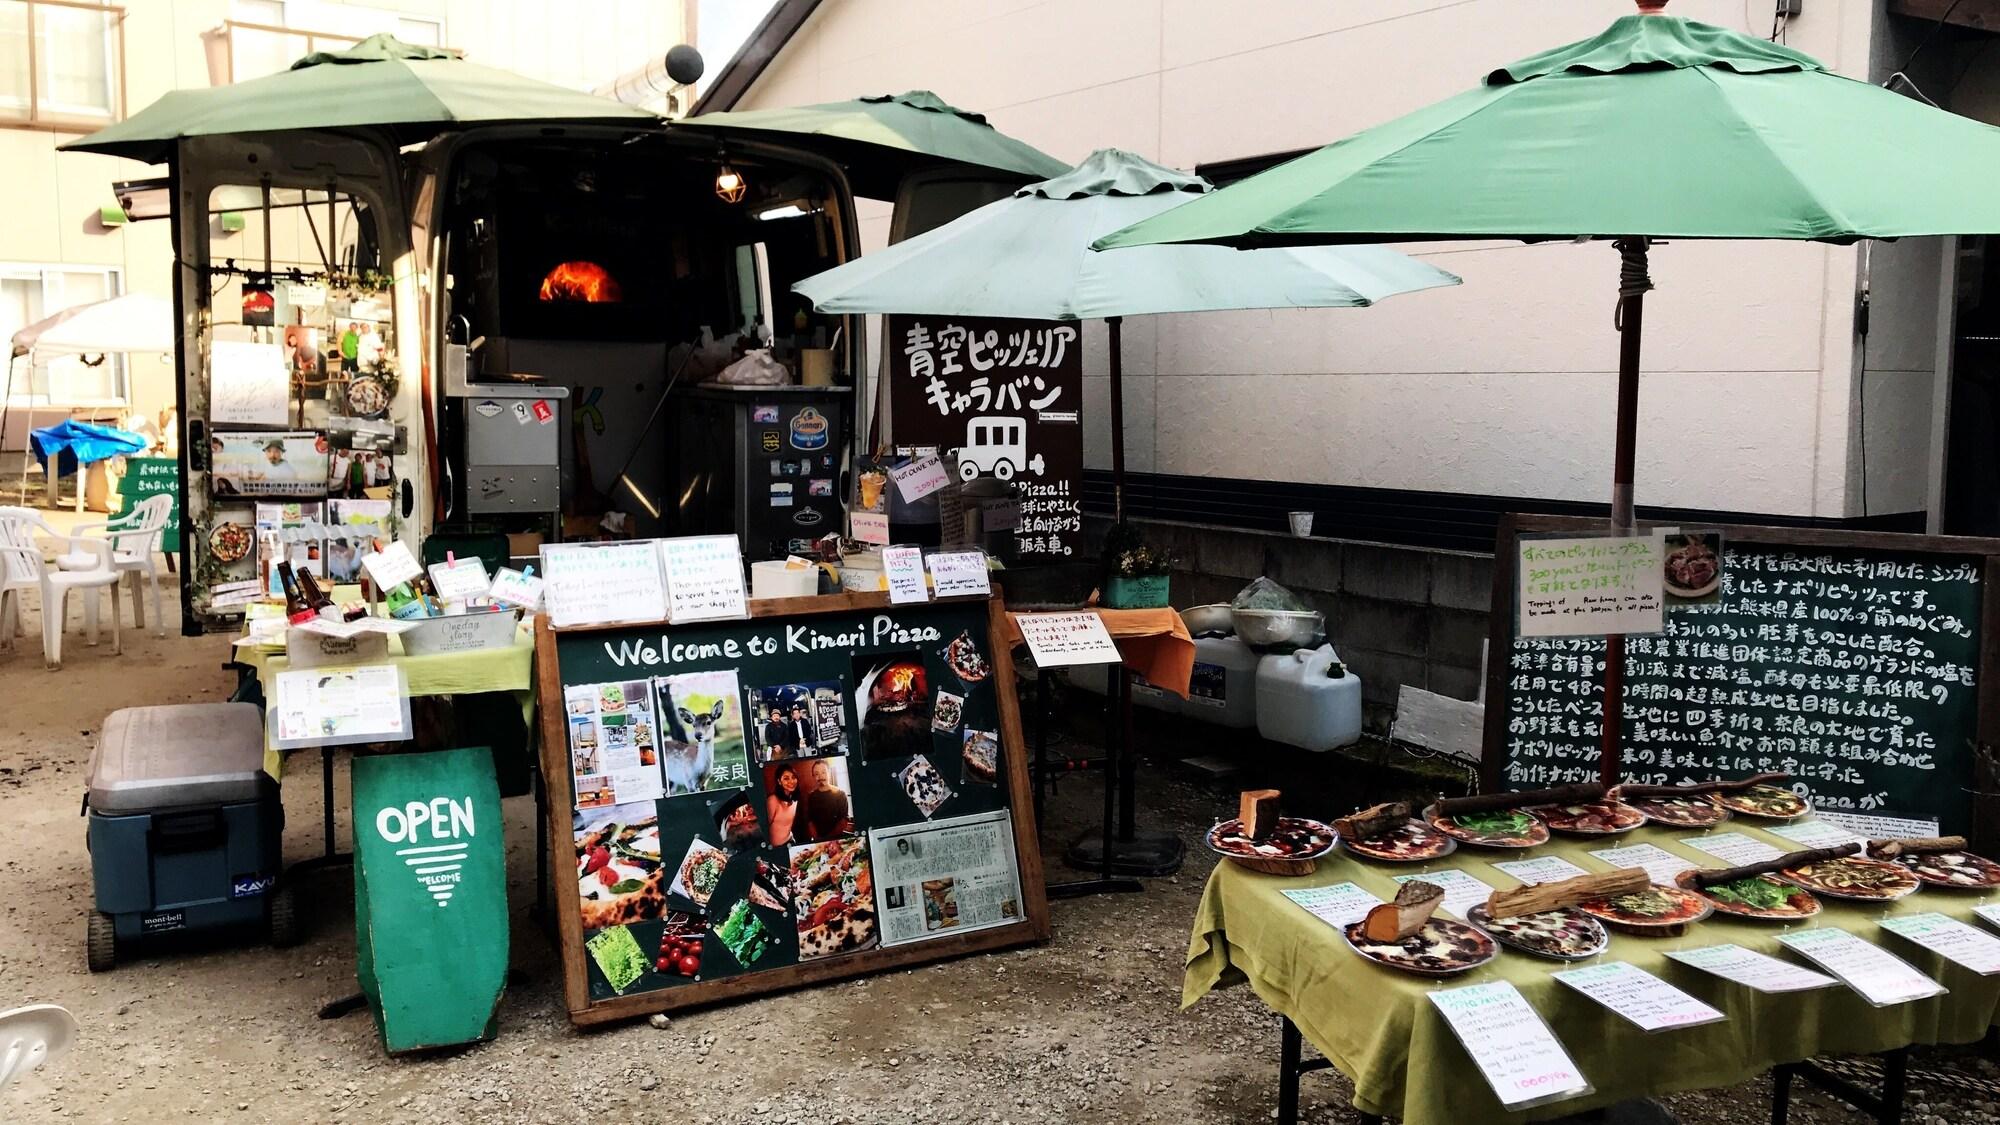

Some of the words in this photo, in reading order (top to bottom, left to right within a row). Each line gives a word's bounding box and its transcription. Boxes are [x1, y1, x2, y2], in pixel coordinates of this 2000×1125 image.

[905, 322, 1076, 377] 青空ピッツェリア
[925, 375, 1062, 415] キャラバン
[604, 635, 743, 667] Welcome
[747, 637, 778, 656] to
[786, 623, 866, 654] Kinari
[872, 614, 941, 647] Pizza
[712, 761, 748, 783] 奈良
[376, 796, 475, 844] OPEN
[235, 876, 276, 893] KAVU
[417, 872, 461, 885] WELCOME
